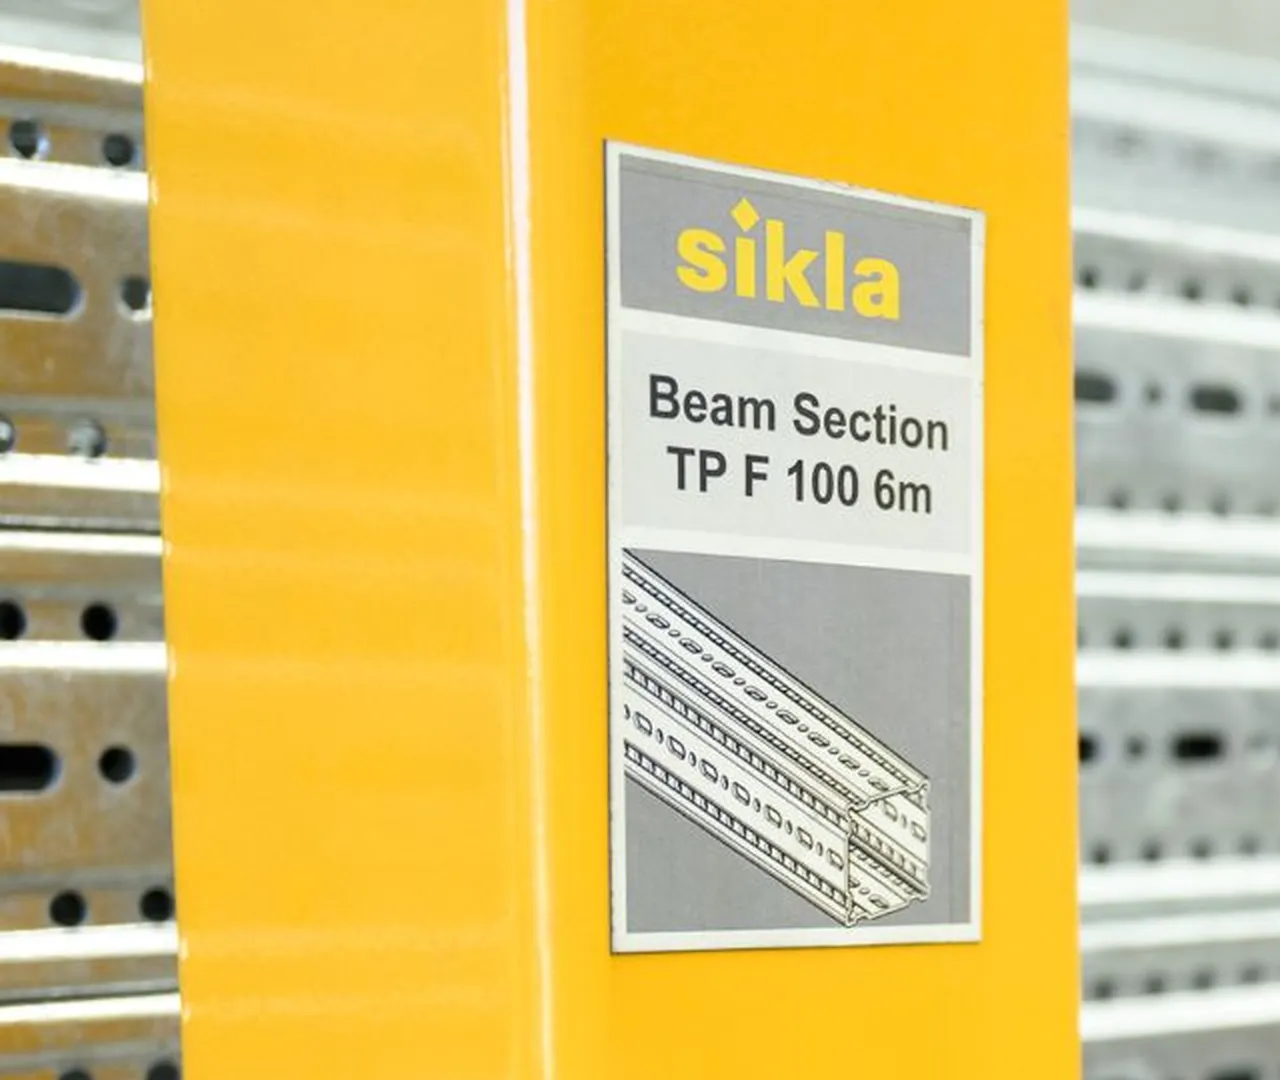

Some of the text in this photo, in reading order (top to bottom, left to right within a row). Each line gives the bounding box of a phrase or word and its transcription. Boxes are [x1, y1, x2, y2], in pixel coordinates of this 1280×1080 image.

[676, 197, 899, 320] sikla
[649, 374, 948, 450] Beam Section
[667, 446, 932, 514] TP F 100 6m
